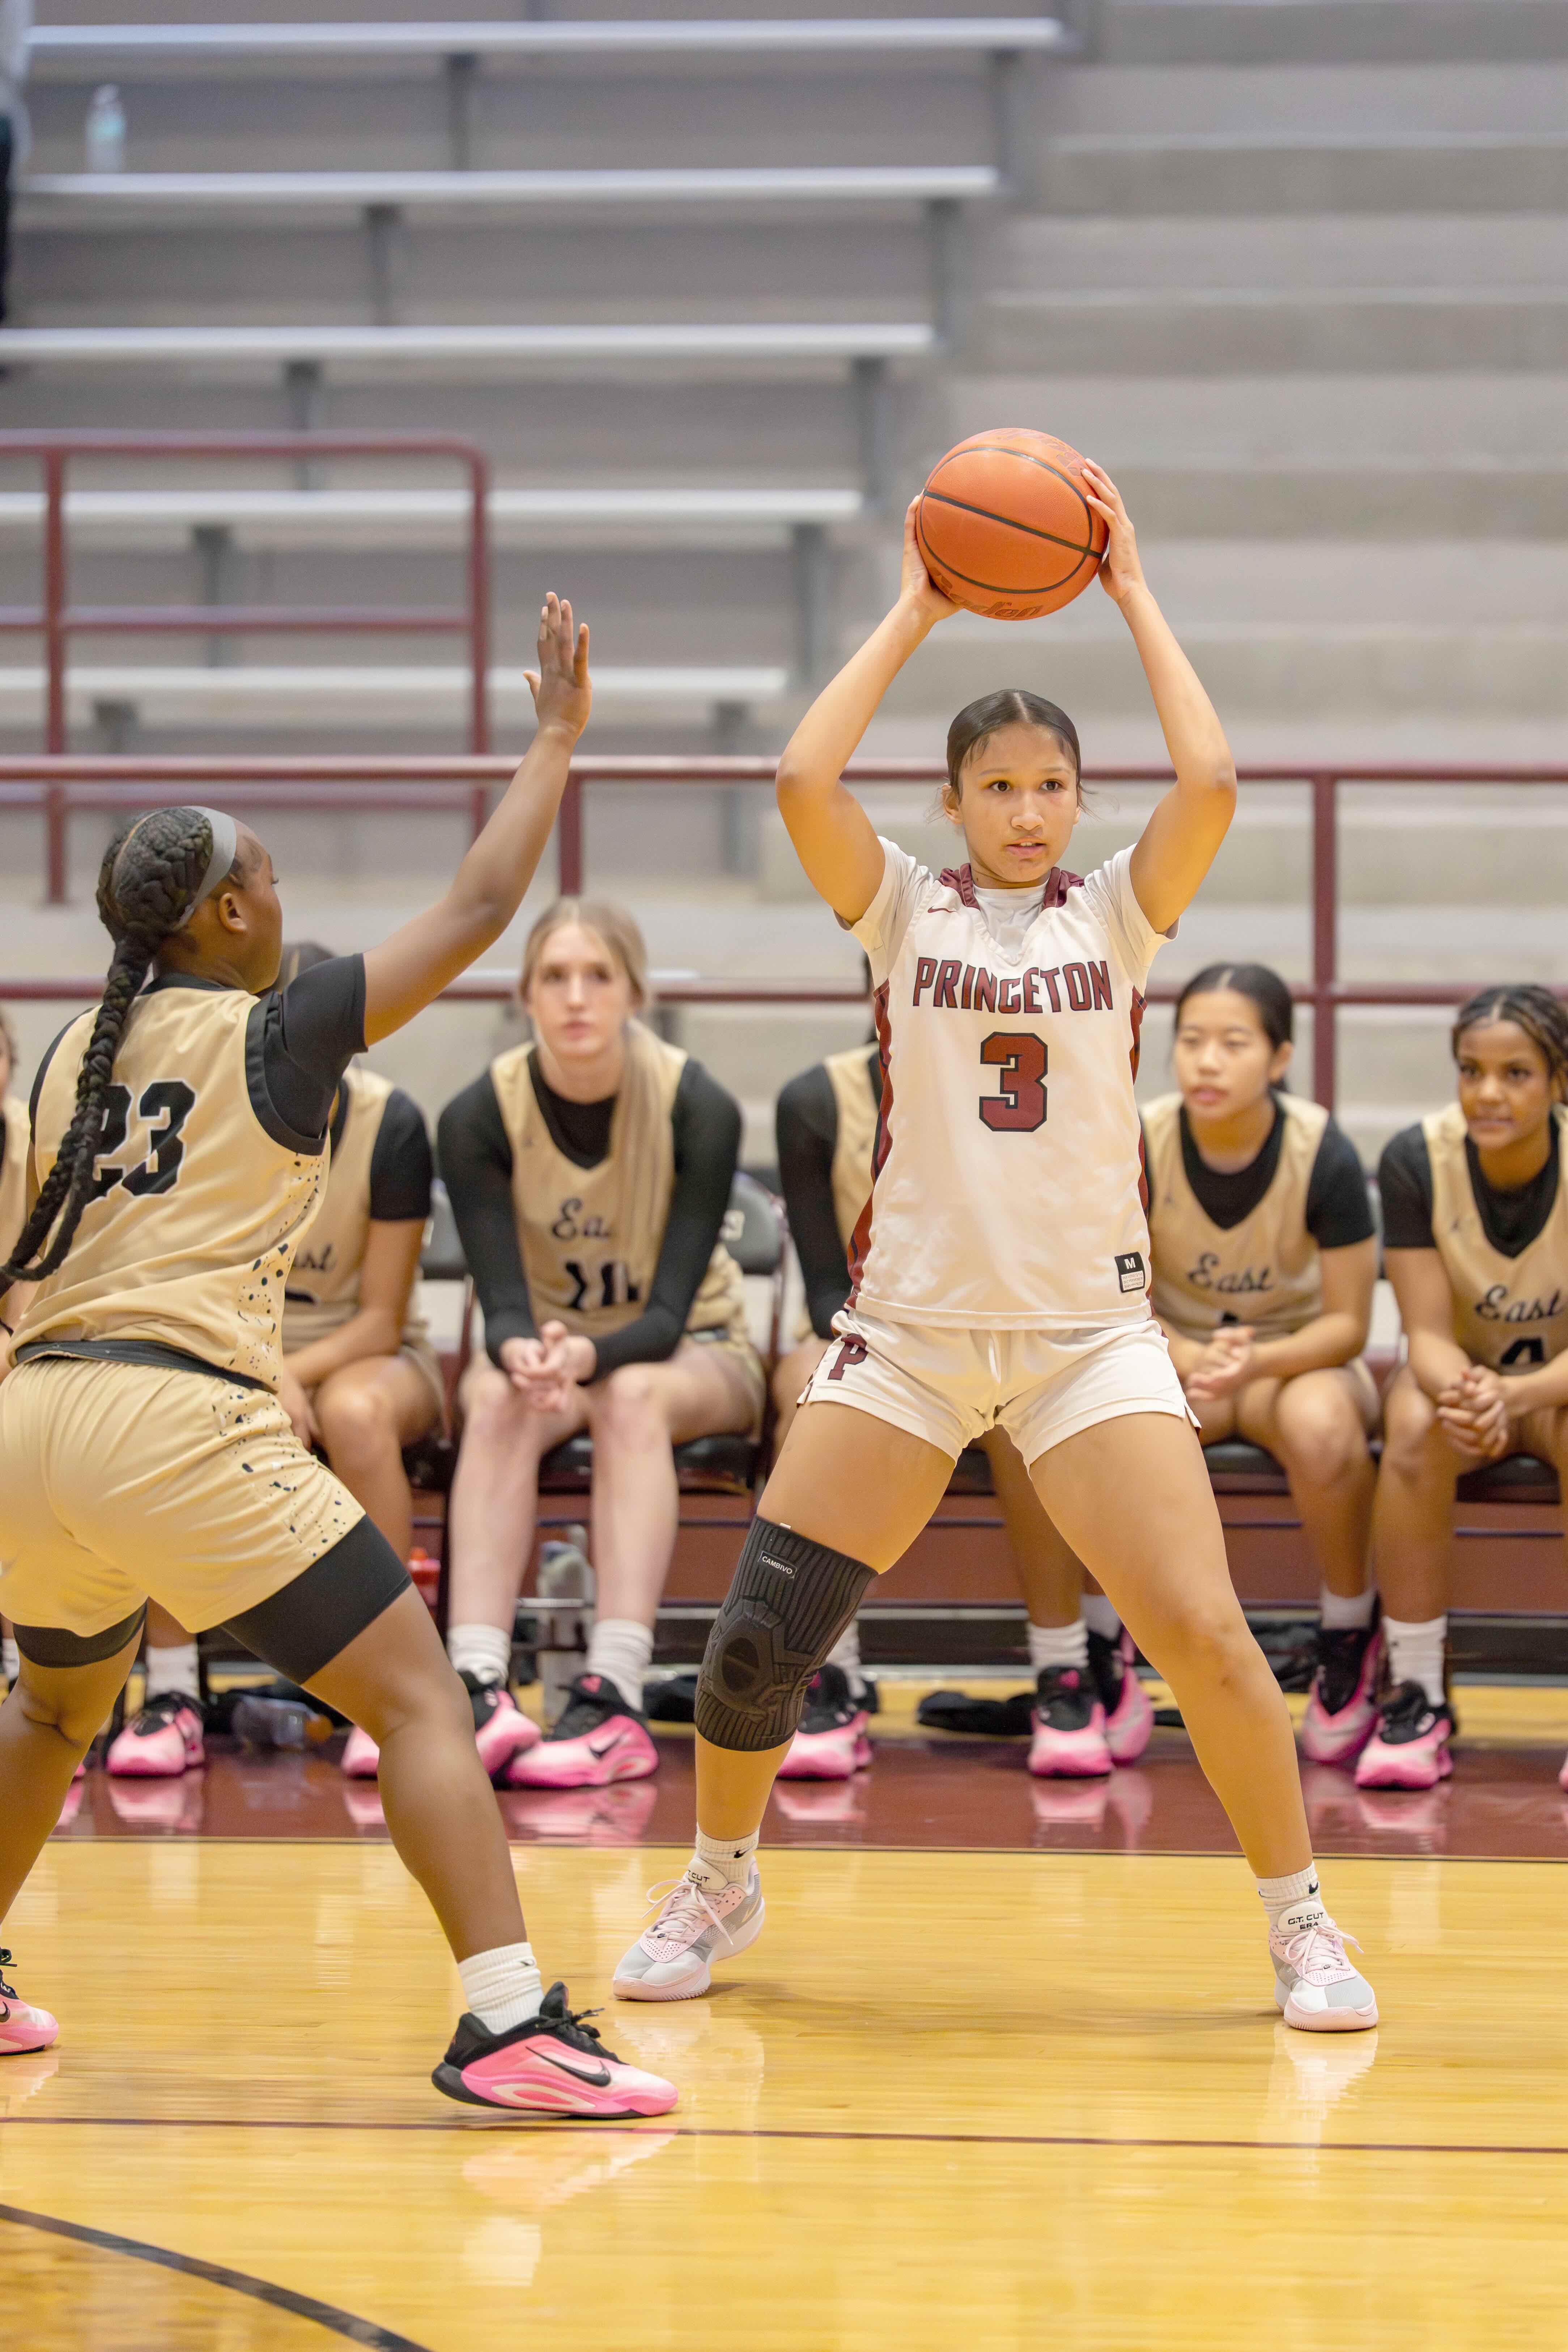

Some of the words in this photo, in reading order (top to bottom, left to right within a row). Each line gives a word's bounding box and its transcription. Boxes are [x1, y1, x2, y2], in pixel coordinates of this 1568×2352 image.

[913, 957, 1113, 1014] PRINCETON
[979, 1031, 1048, 1132] 3
[87, 1079, 197, 1204] 23
[1124, 1257, 1136, 1269] M
[1187, 1251, 1273, 1293] East
[1475, 1284, 1564, 1322] East
[827, 1333, 869, 1381] P
[762, 1556, 793, 1574] CAMBIVO
[1288, 1916, 1304, 1925] G.T.
[1306, 1912, 1324, 1921] CUT
[1300, 1921, 1319, 1930] ERA
